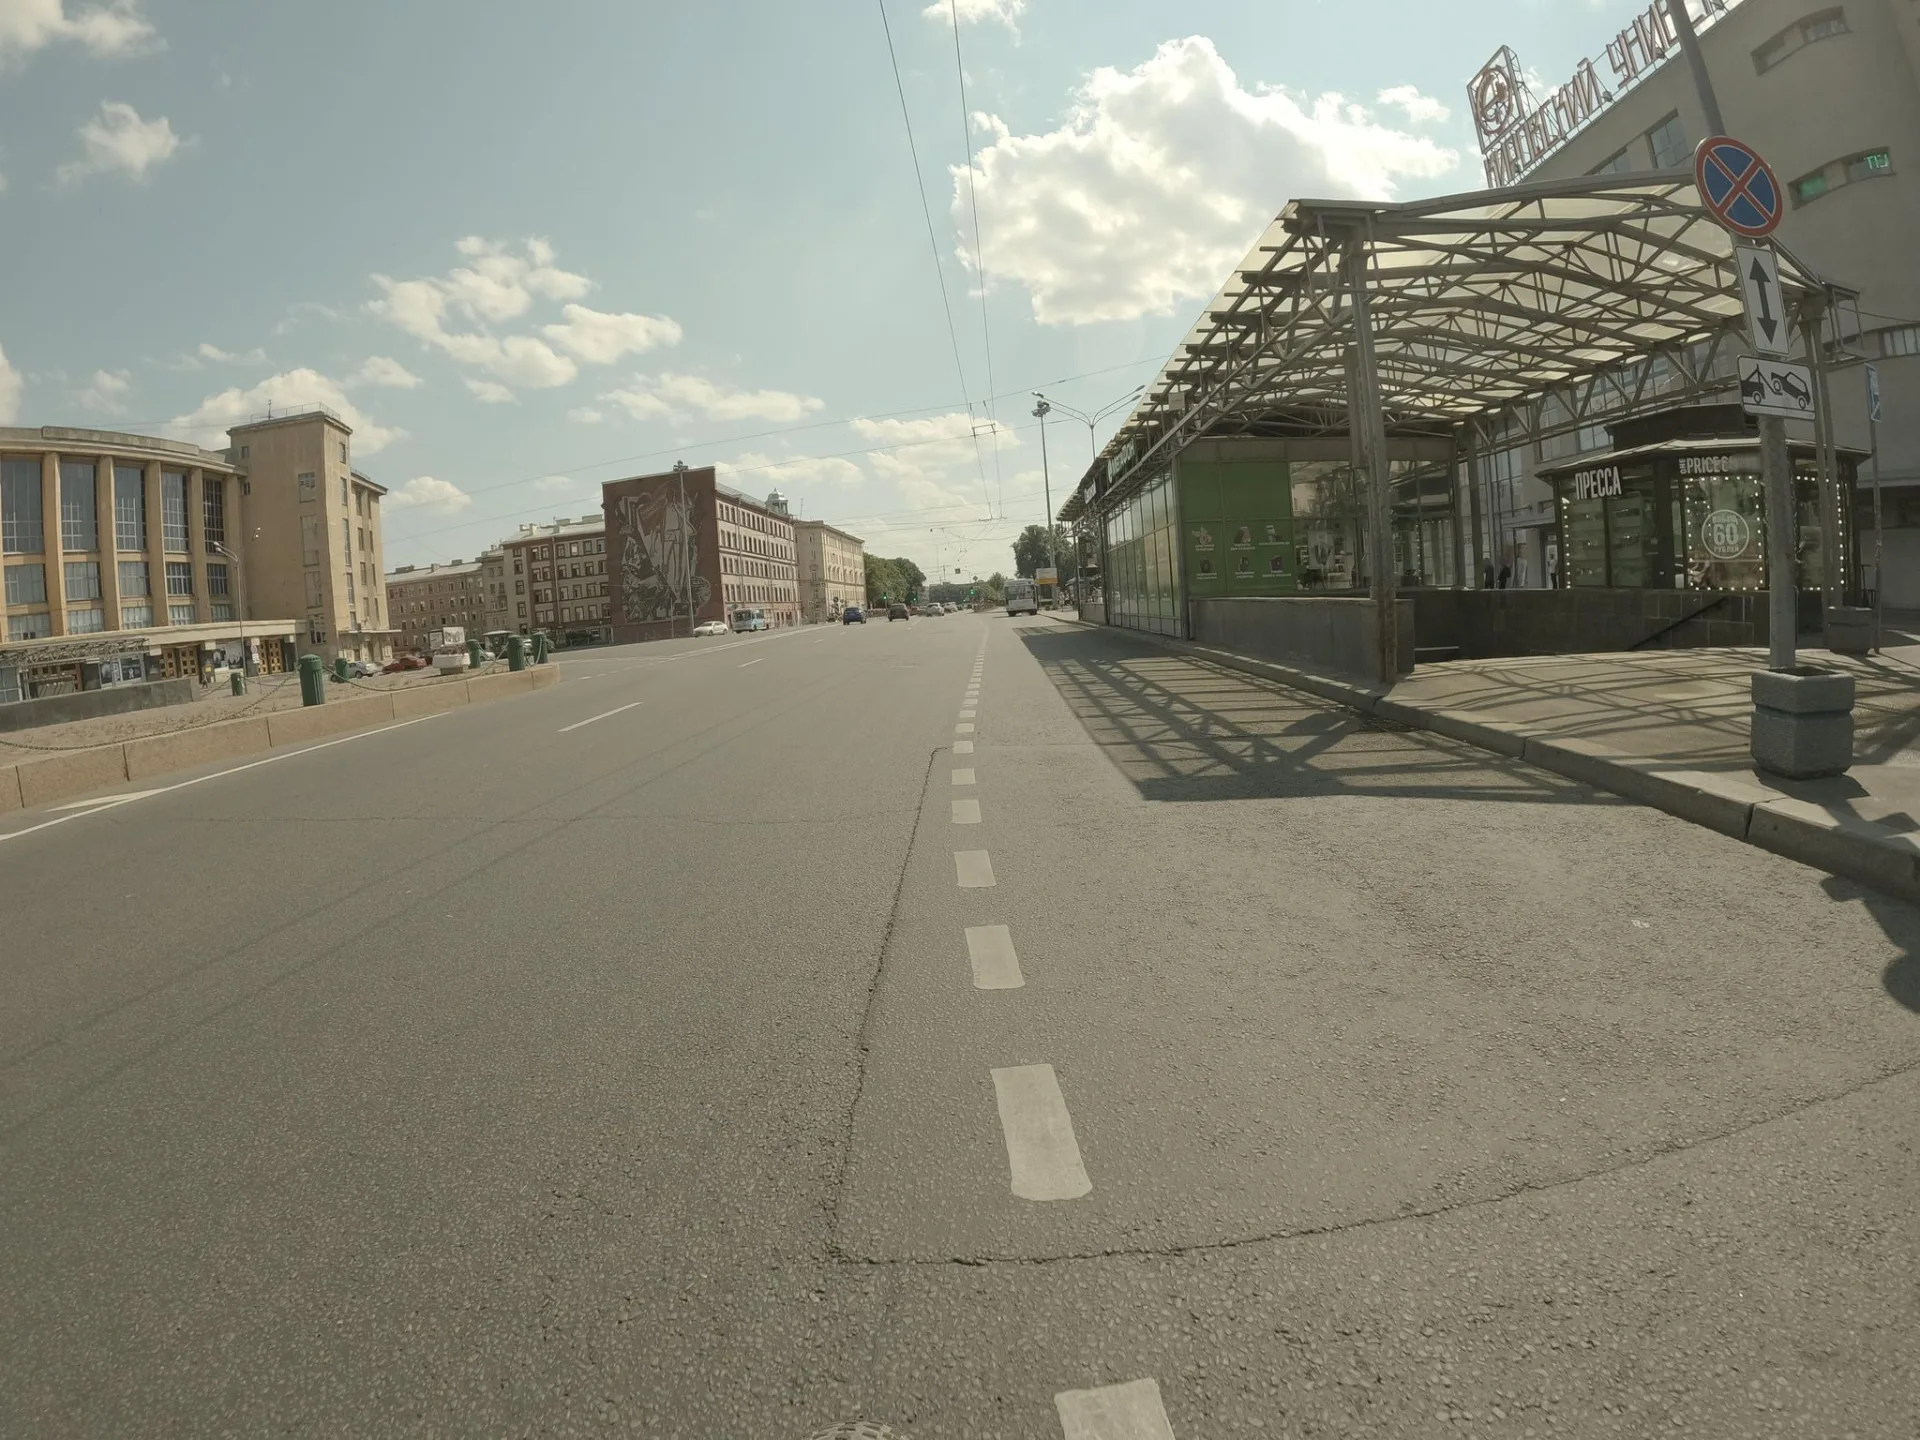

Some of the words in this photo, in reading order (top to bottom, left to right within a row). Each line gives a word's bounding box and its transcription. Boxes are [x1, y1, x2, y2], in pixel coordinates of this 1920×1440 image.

[1483, 57, 1603, 188] КИРОВСКИЙ
[1606, 0, 1711, 88] УНИВ
[1686, 456, 1720, 474] PRICE
[1575, 465, 1622, 500] ПРЕССА
[1713, 523, 1738, 545] 60
